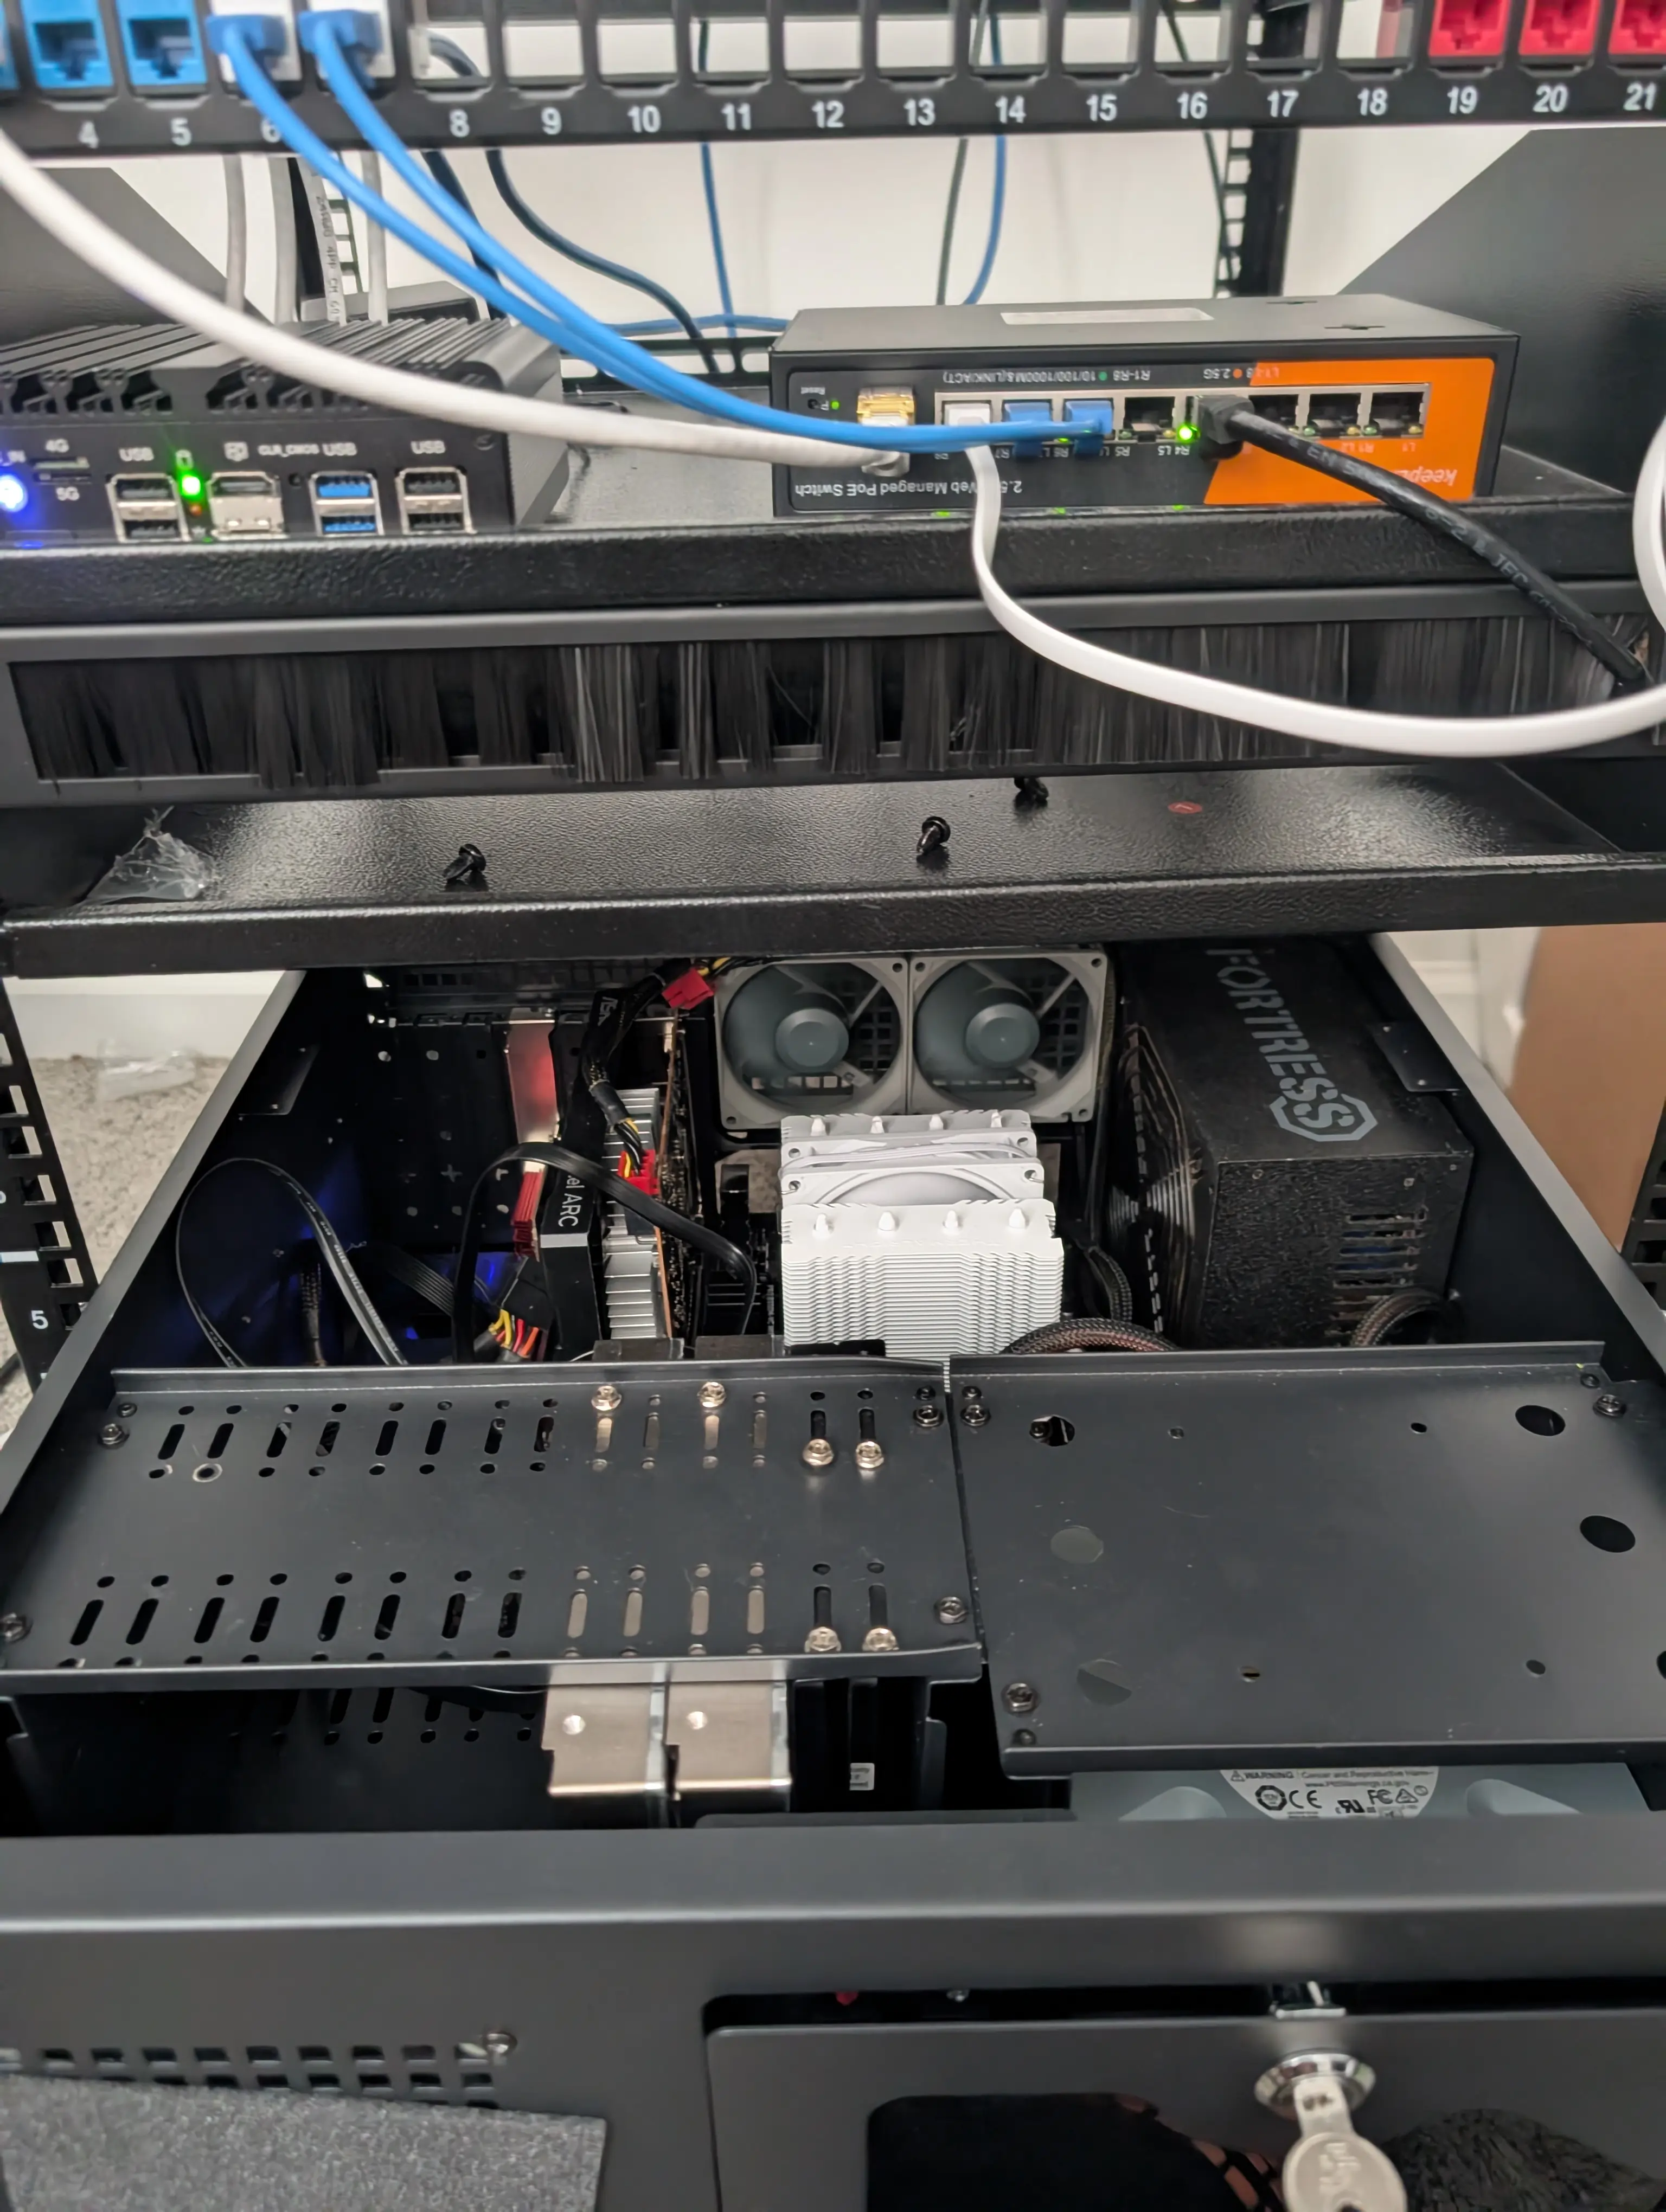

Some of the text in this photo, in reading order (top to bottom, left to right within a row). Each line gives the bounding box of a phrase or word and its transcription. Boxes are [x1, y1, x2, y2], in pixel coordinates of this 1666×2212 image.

[78, 82, 1657, 149] 4 5 6 8 9 10 11 12 13 14 15 16 17 18 19 20 21
[1203, 368, 1232, 380] 2.5G
[119, 447, 154, 462] USB
[322, 441, 358, 456] USB
[411, 440, 447, 454] USB
[1157, 445, 1172, 456] L5
[794, 483, 843, 497] Switch
[847, 483, 877, 497] PoE
[880, 480, 948, 496] Managed
[1206, 948, 1356, 1129] FORTRESS
[558, 1193, 584, 1227] ARC
[31, 1309, 49, 1329] 5
